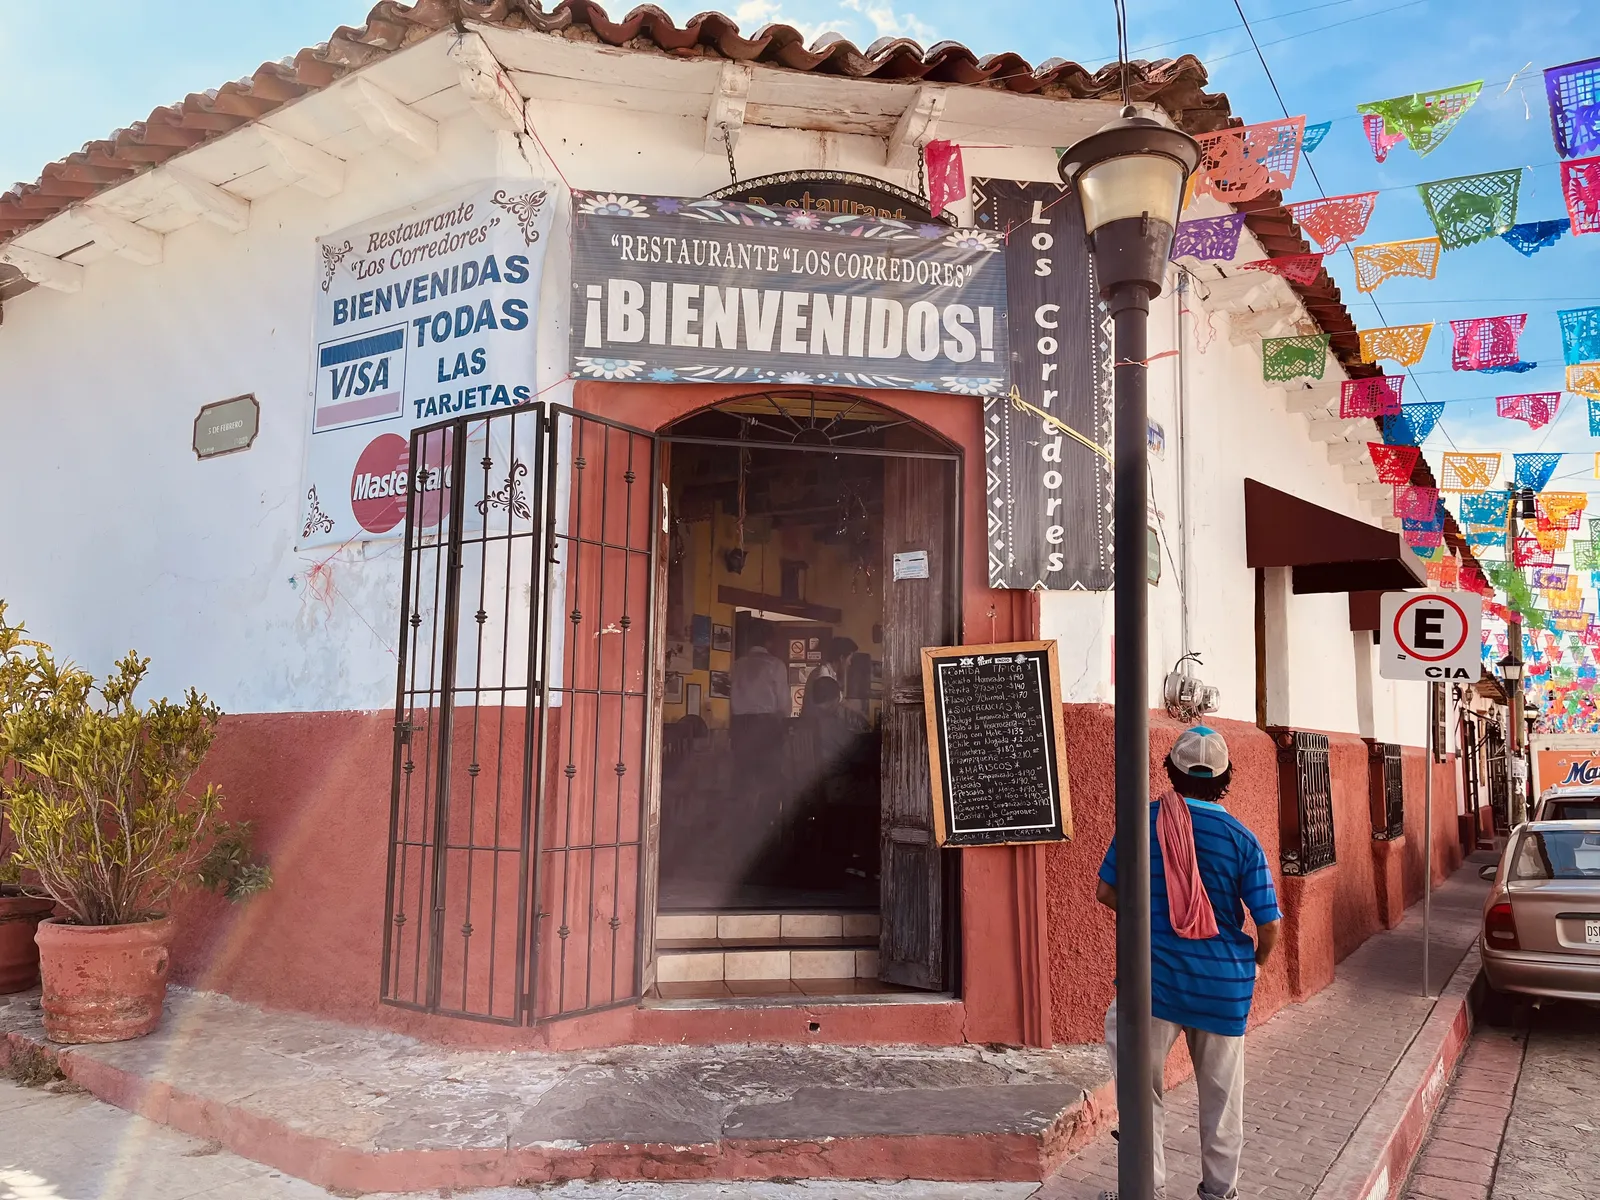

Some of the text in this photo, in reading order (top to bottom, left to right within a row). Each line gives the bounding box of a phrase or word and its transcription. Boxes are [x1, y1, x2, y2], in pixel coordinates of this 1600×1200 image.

[748, 190, 907, 219] stauran
[366, 202, 474, 254] Restaurante
[351, 217, 501, 283] “Los Corredores”
[834, 251, 973, 289] CORREDORES”
[332, 254, 530, 327] BIENVENIDAS
[412, 298, 529, 348] TODAS
[584, 278, 995, 364] ¡BIENVENIDOS!
[329, 356, 391, 401] VISA
[437, 346, 487, 384] LAS
[413, 384, 531, 420] TARJETAS
[1030, 200, 1066, 572] Los Corredores
[212, 426, 220, 434] DE
[220, 420, 243, 432] FEBRERO
[352, 464, 452, 502] MasteCar
[1414, 608, 1444, 649] E
[1425, 666, 1470, 679] CIA
[1560, 760, 1600, 785] Ma
[1587, 926, 1600, 936] DS
